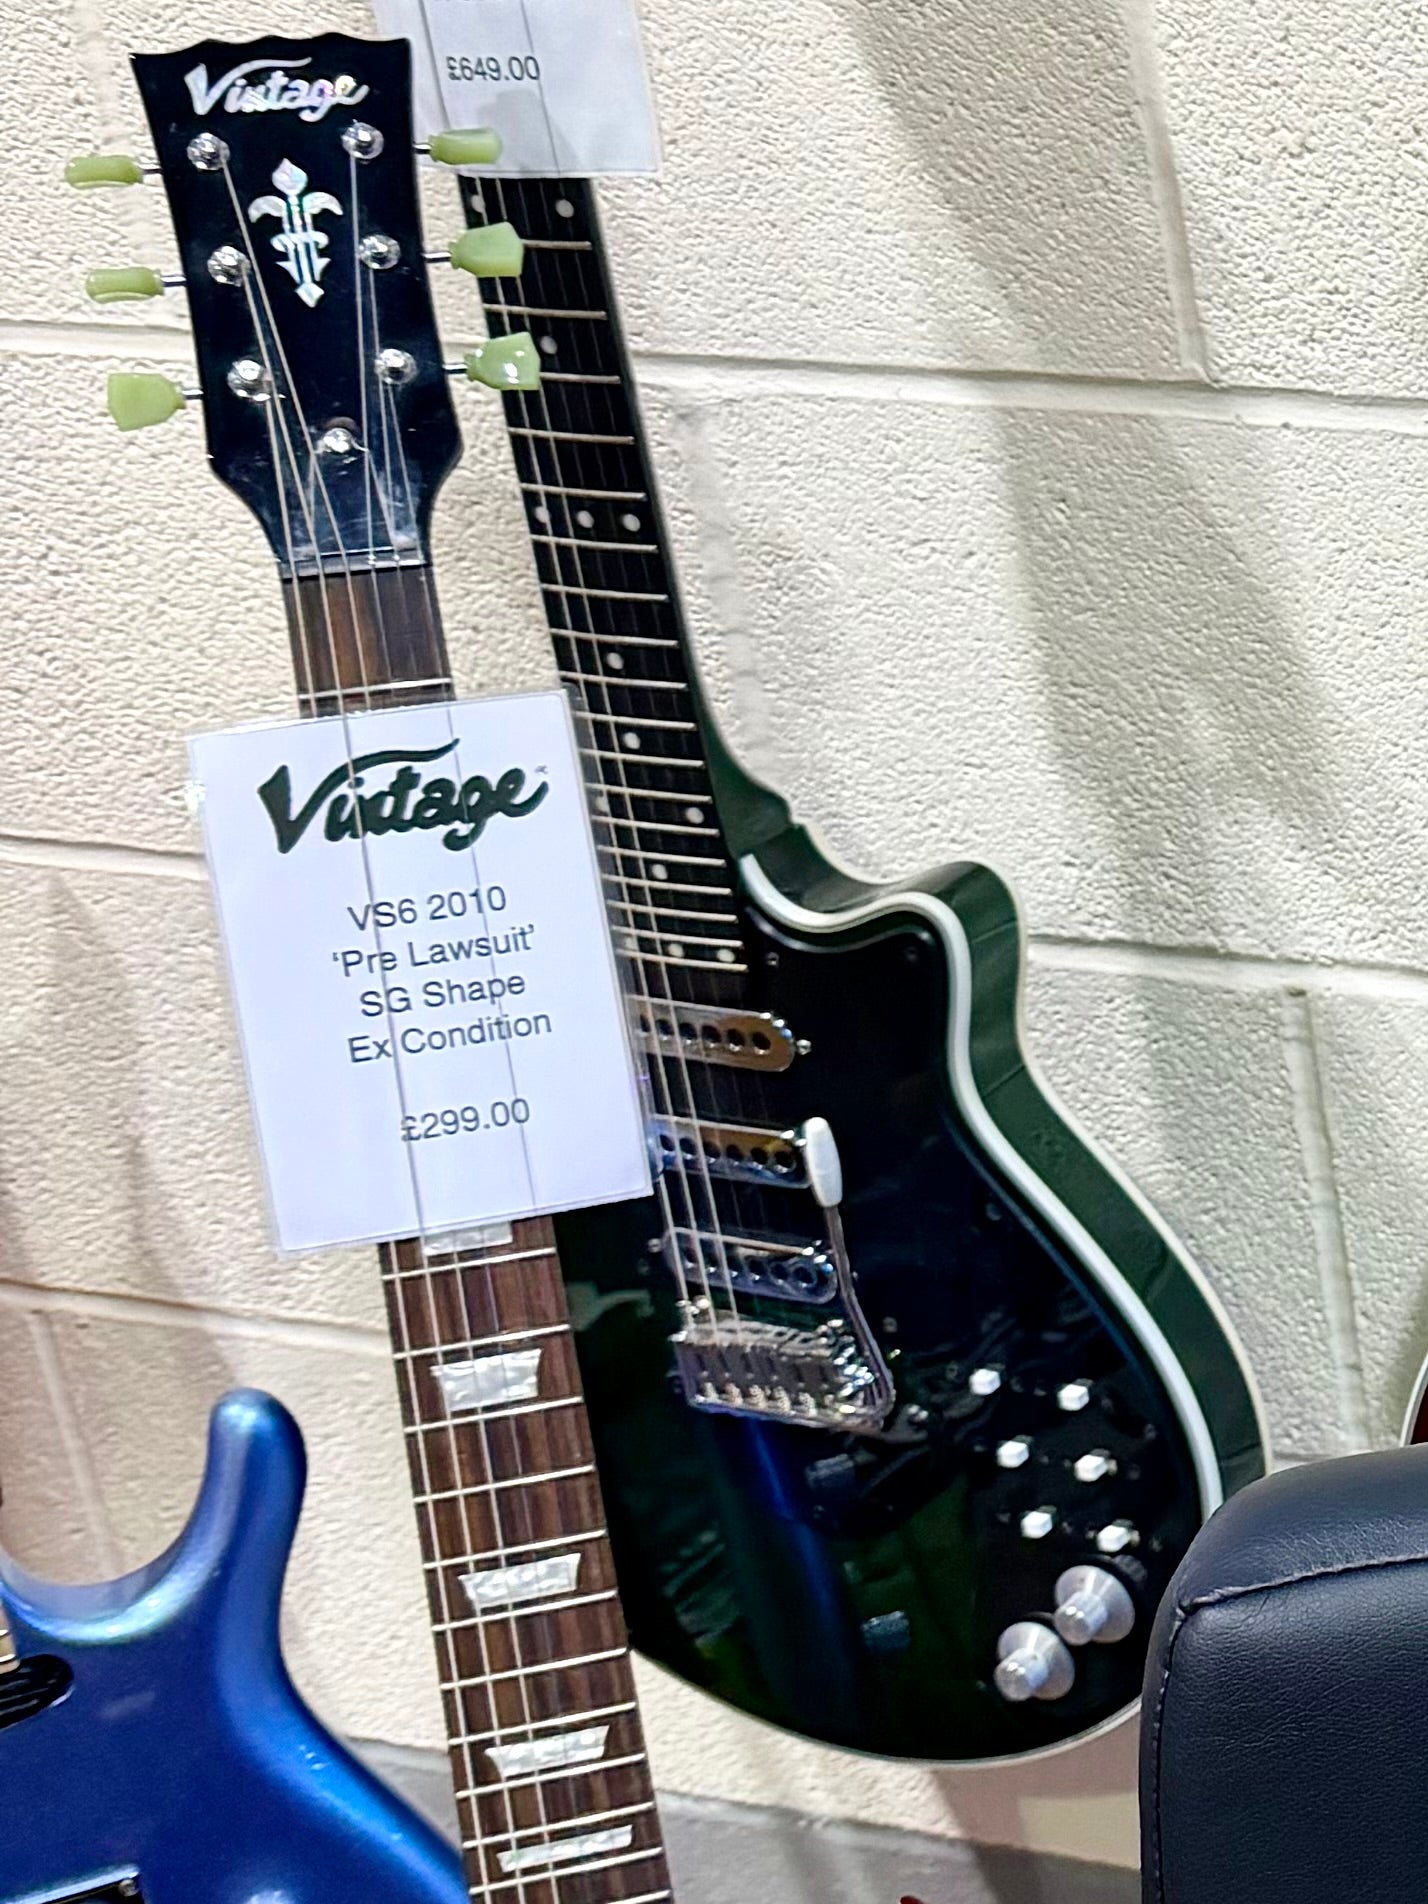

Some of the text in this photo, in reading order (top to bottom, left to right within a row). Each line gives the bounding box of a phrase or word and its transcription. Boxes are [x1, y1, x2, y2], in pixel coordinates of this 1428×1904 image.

[184, 56, 370, 123] Vintage
[446, 56, 540, 81] £649.00
[256, 737, 549, 854] Vintage
[346, 885, 506, 932] VS6 2010
[359, 974, 526, 1018] SG Shape
[347, 1013, 552, 1063] Ex Condition
[401, 1098, 530, 1142] £299.00
